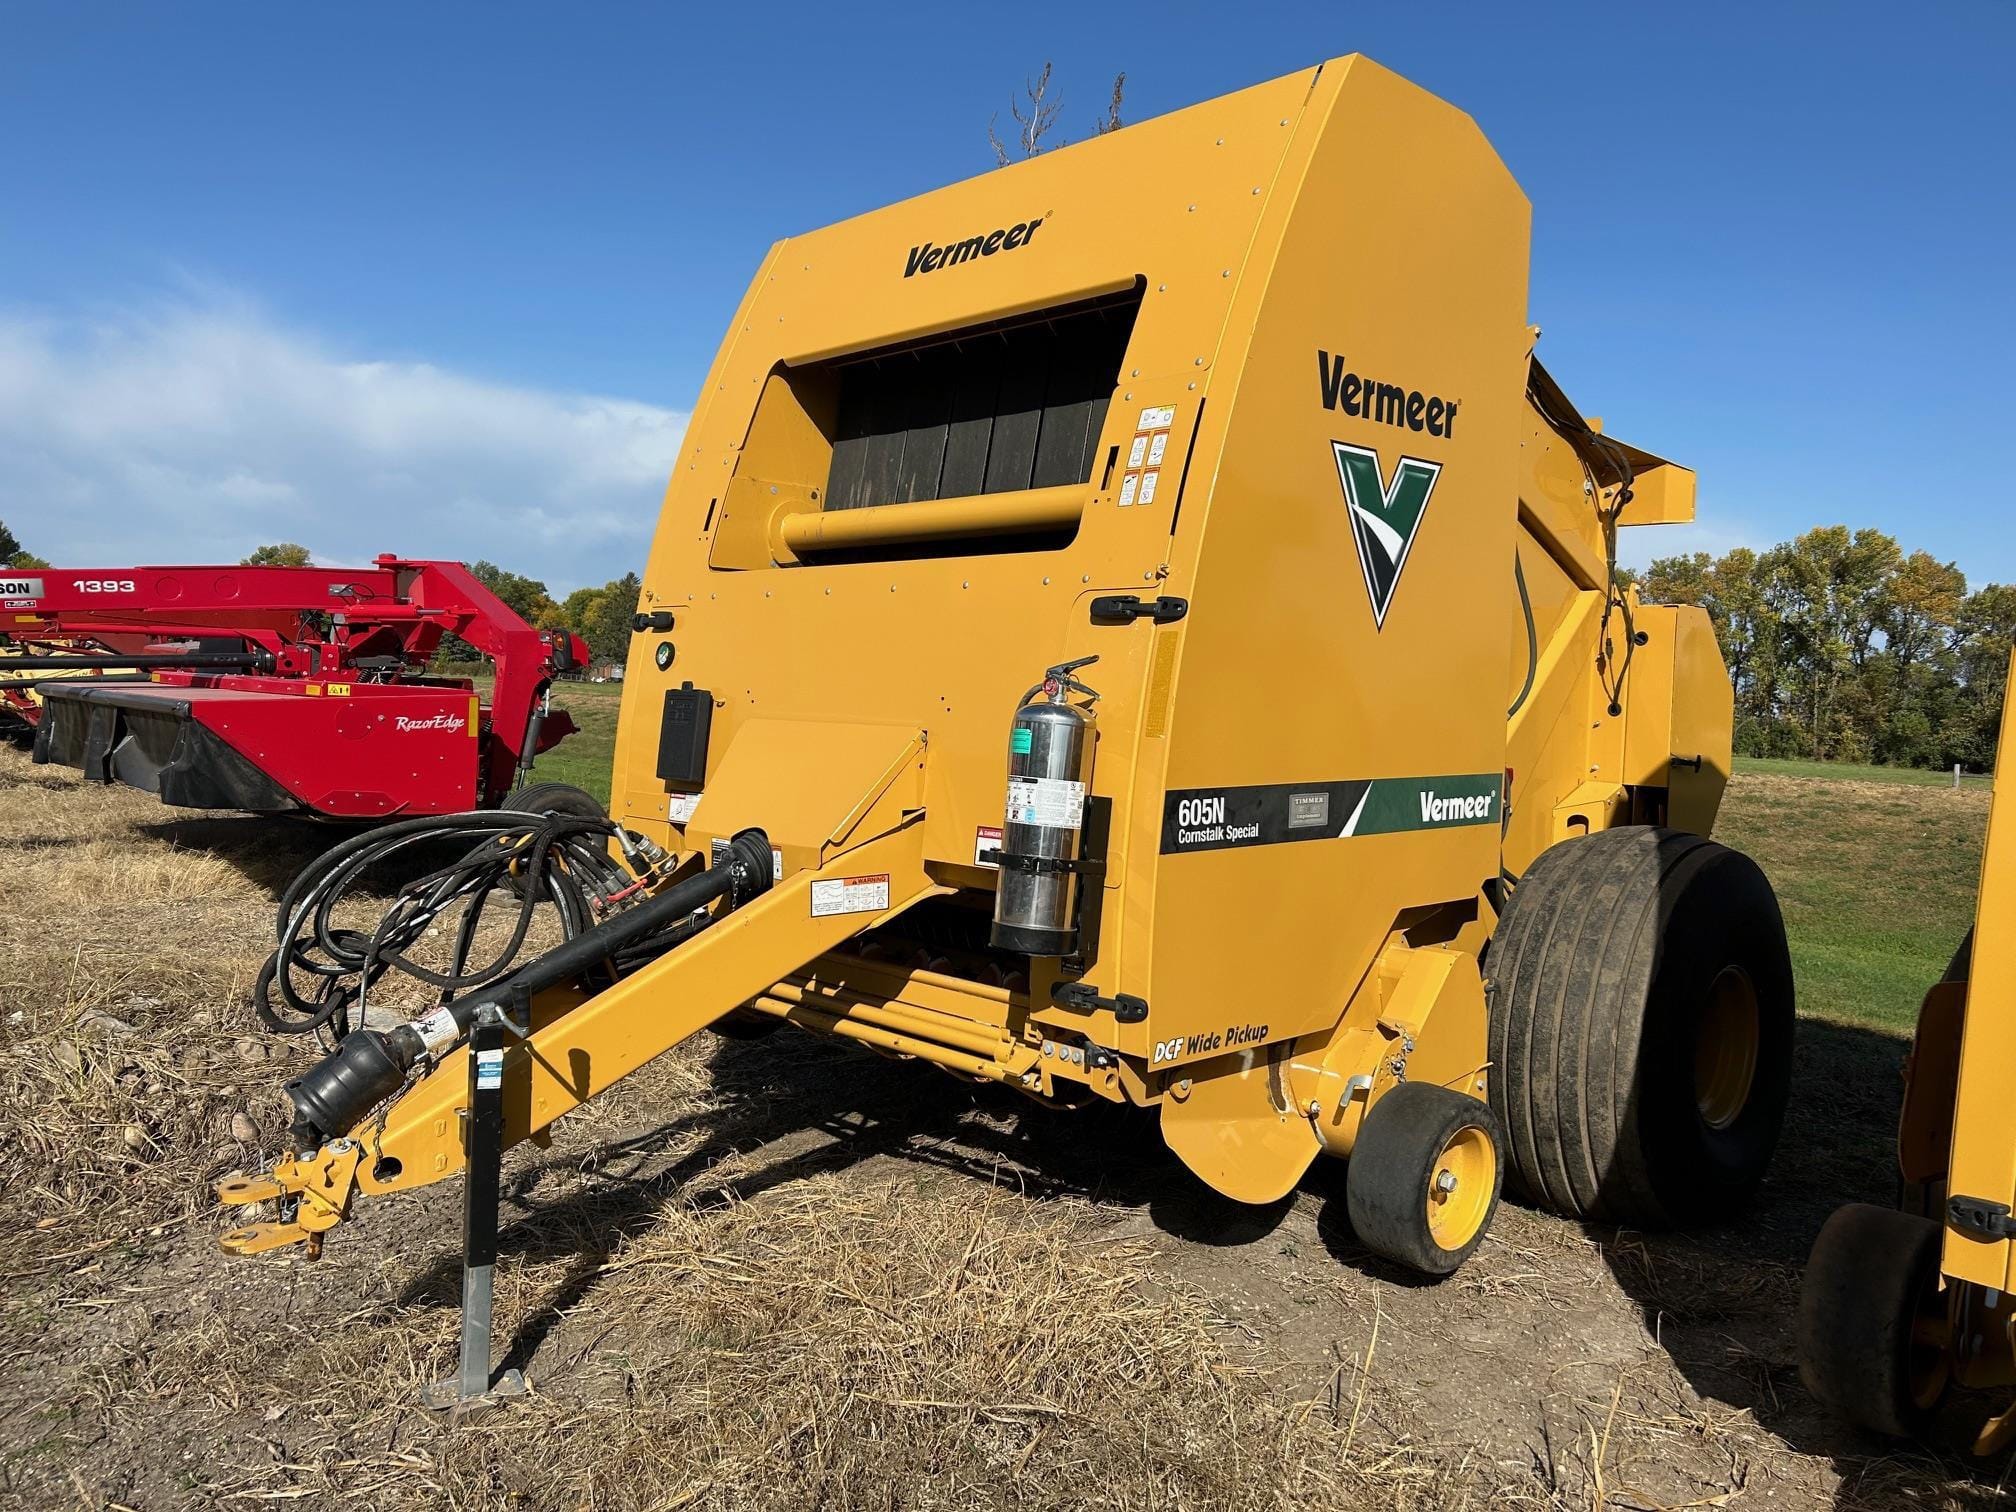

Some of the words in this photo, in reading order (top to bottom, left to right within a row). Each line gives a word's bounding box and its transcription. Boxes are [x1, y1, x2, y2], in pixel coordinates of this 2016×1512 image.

[903, 217, 1044, 279] Vermeer
[1317, 349, 1458, 440] Vermeer
[72, 579, 136, 593] 1393
[394, 712, 465, 734] RazorEdge
[1178, 796, 1225, 827] 605N
[1420, 790, 1492, 823] Vermeer
[1178, 826, 1225, 844] Cornstalk
[1226, 822, 1260, 843] Special
[1153, 1037, 1184, 1064] DCF
[1186, 1031, 1221, 1056] Wide
[1225, 1023, 1269, 1047] Pickup
